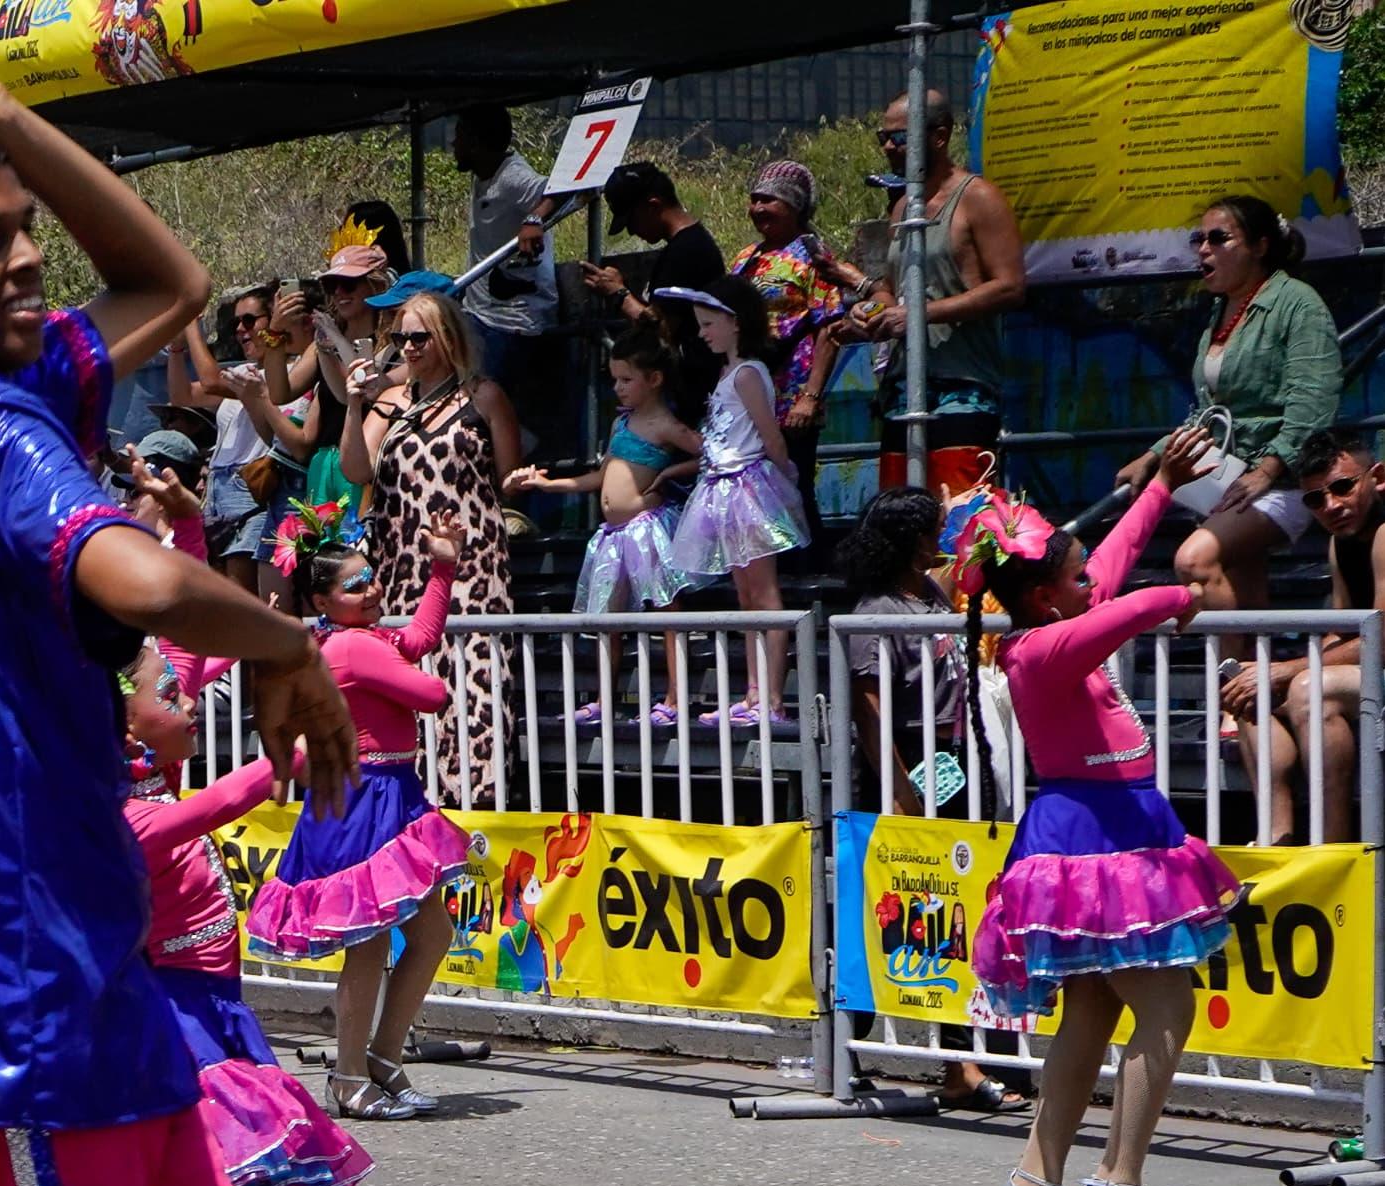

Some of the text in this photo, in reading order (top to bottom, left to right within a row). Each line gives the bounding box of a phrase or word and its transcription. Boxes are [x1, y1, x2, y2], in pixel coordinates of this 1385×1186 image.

[1102, 14, 1124, 27] para
[1128, 11, 1148, 21] una
[1150, 7, 1181, 22] mejor
[1186, 1, 1254, 17] experiencia
[1054, 36, 1066, 49] los
[1069, 31, 1118, 48] minipalcos
[1121, 27, 1135, 41] del
[1139, 24, 1186, 40] carnaval
[1190, 21, 1221, 35] 2025
[582, 86, 627, 105] MINIPALCO
[574, 119, 617, 181] 7
[891, 854, 940, 865] BARRANQUILLA
[927, 991, 943, 1008] 2025
